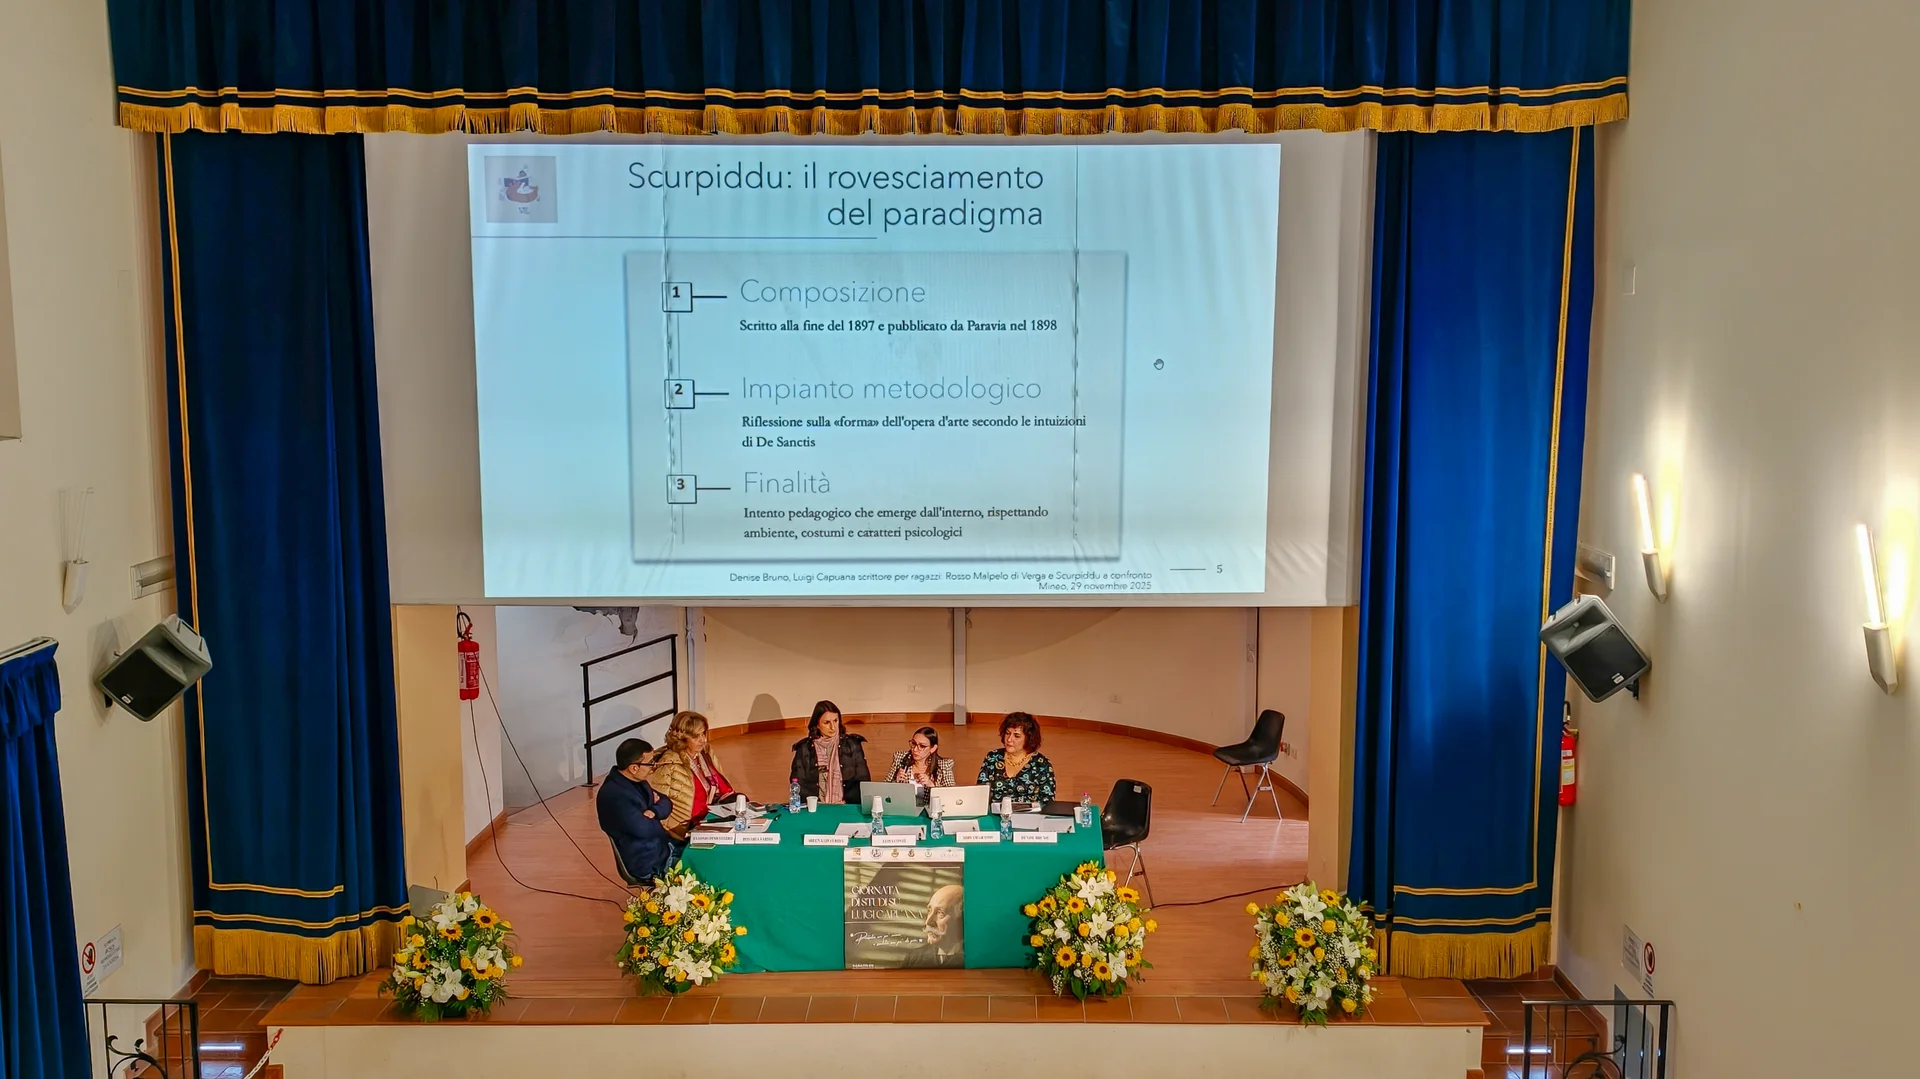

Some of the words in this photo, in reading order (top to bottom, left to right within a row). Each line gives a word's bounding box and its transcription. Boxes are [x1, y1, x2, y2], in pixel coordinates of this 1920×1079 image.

[629, 161, 792, 196] Scurpiddu:
[804, 162, 817, 189] il
[828, 164, 1044, 190] rovesciamento
[827, 198, 872, 226] del
[883, 198, 1042, 234] paradigma
[672, 286, 680, 298] 1
[740, 278, 926, 311] Composizione
[739, 319, 778, 332] Scritto
[780, 319, 800, 332] alla
[802, 319, 825, 332] fine
[826, 319, 845, 332] del
[848, 319, 876, 332] 1897
[877, 323, 886, 332] e
[887, 319, 948, 336] pubblicato
[949, 319, 965, 332] da
[966, 319, 1007, 332] Paravia
[1009, 319, 1027, 332] nel
[1030, 319, 1058, 331] 1898
[674, 383, 683, 395] 2
[742, 376, 854, 406] Impianto
[863, 374, 1042, 406] metodologico
[741, 415, 804, 428] Riflessione
[806, 415, 832, 428] sulla
[833, 415, 880, 428] «forma»
[881, 415, 936, 431] dell'opera
[937, 415, 970, 428] d'arte
[971, 415, 1019, 427] secondo
[1020, 415, 1032, 427] le
[1034, 415, 1087, 428] intuizioni
[741, 435, 754, 448] di
[755, 436, 774, 448] De
[776, 435, 816, 448] Sanctis
[676, 478, 685, 490] 3
[744, 469, 831, 494] Finalità
[743, 507, 786, 519] Intento
[787, 506, 852, 522] pedagogico
[854, 506, 875, 519] che
[876, 509, 918, 522] emerge
[919, 505, 985, 520] dall'interno,
[986, 505, 1049, 521] rispettando
[743, 526, 799, 541] ambiente,
[800, 526, 845, 538] costumi
[847, 529, 855, 538] e
[856, 526, 902, 538] caratteri
[904, 525, 963, 541] psicologici
[1216, 563, 1224, 574] 5
[729, 572, 761, 582] Denise
[792, 572, 815, 584] Luigi
[815, 572, 856, 583] Capuana
[857, 573, 893, 581] scrittore
[894, 574, 910, 582] per
[945, 571, 972, 581] Rosso
[972, 571, 1009, 582] Malpelo
[1010, 571, 1020, 580] di
[1021, 571, 1046, 582] Verga
[1056, 570, 1101, 582] Scurpiddu
[1110, 570, 1153, 580] confronto
[1071, 582, 1081, 590] 29
[1084, 581, 1128, 590] novembre
[1130, 581, 1152, 590] 2025
[851, 885, 900, 896] GIORNATA
[876, 909, 925, 920] CAPUANA
